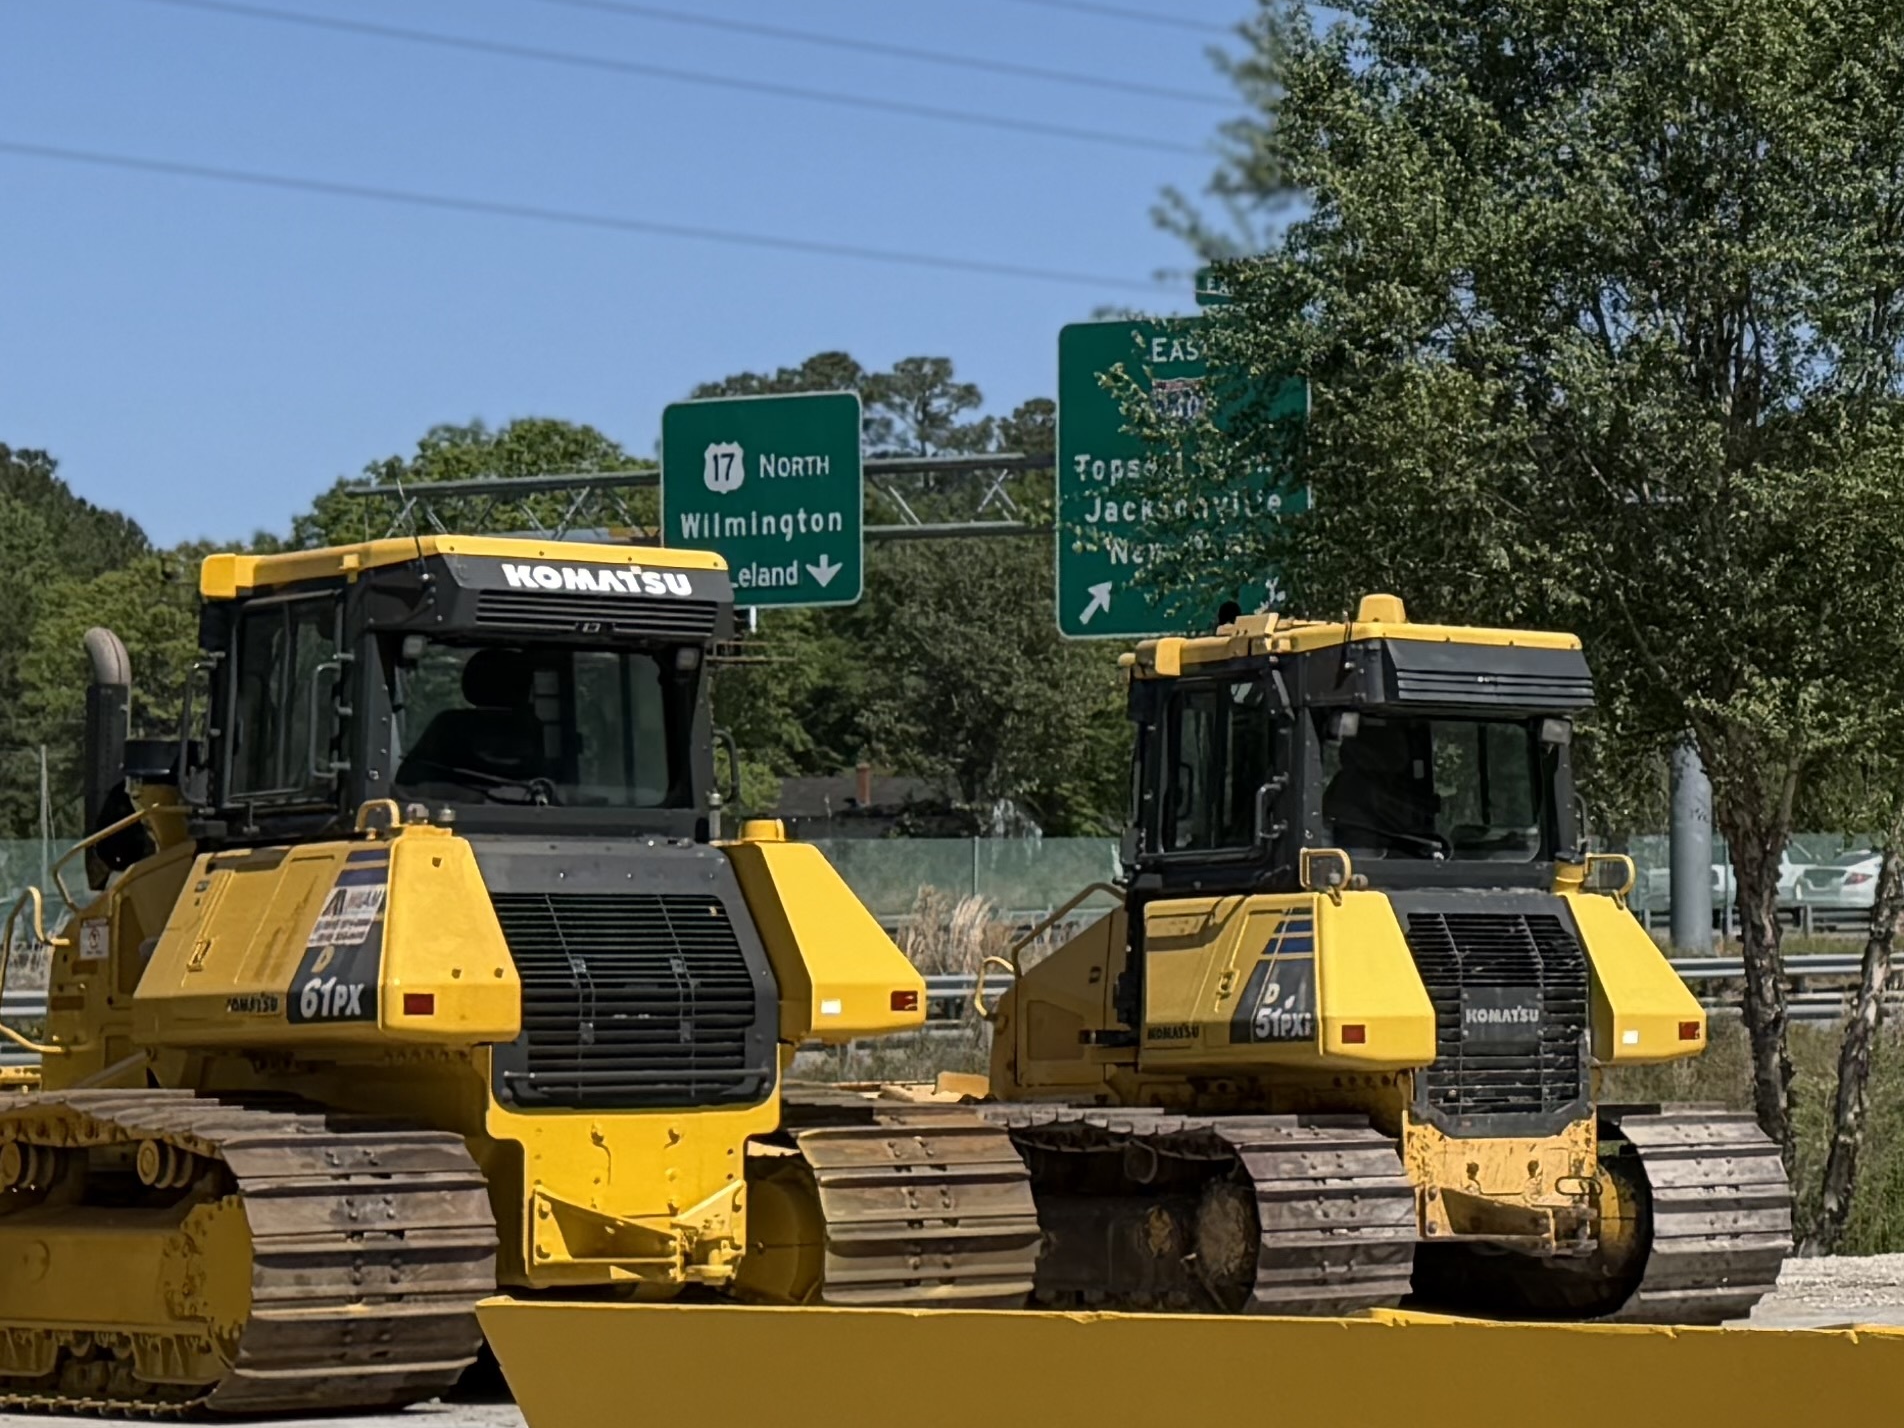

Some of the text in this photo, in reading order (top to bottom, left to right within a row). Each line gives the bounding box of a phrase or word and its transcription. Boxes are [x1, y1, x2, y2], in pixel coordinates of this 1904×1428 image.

[1152, 337, 1208, 363] EAS
[712, 453, 829, 481] 17 NORTH
[681, 508, 842, 542] Wilmington
[501, 564, 692, 596] KOMATSU
[310, 945, 336, 974] D
[300, 977, 365, 1019] 61PX
[1262, 982, 1281, 1005] D
[1465, 1005, 1539, 1024] KOMATSU
